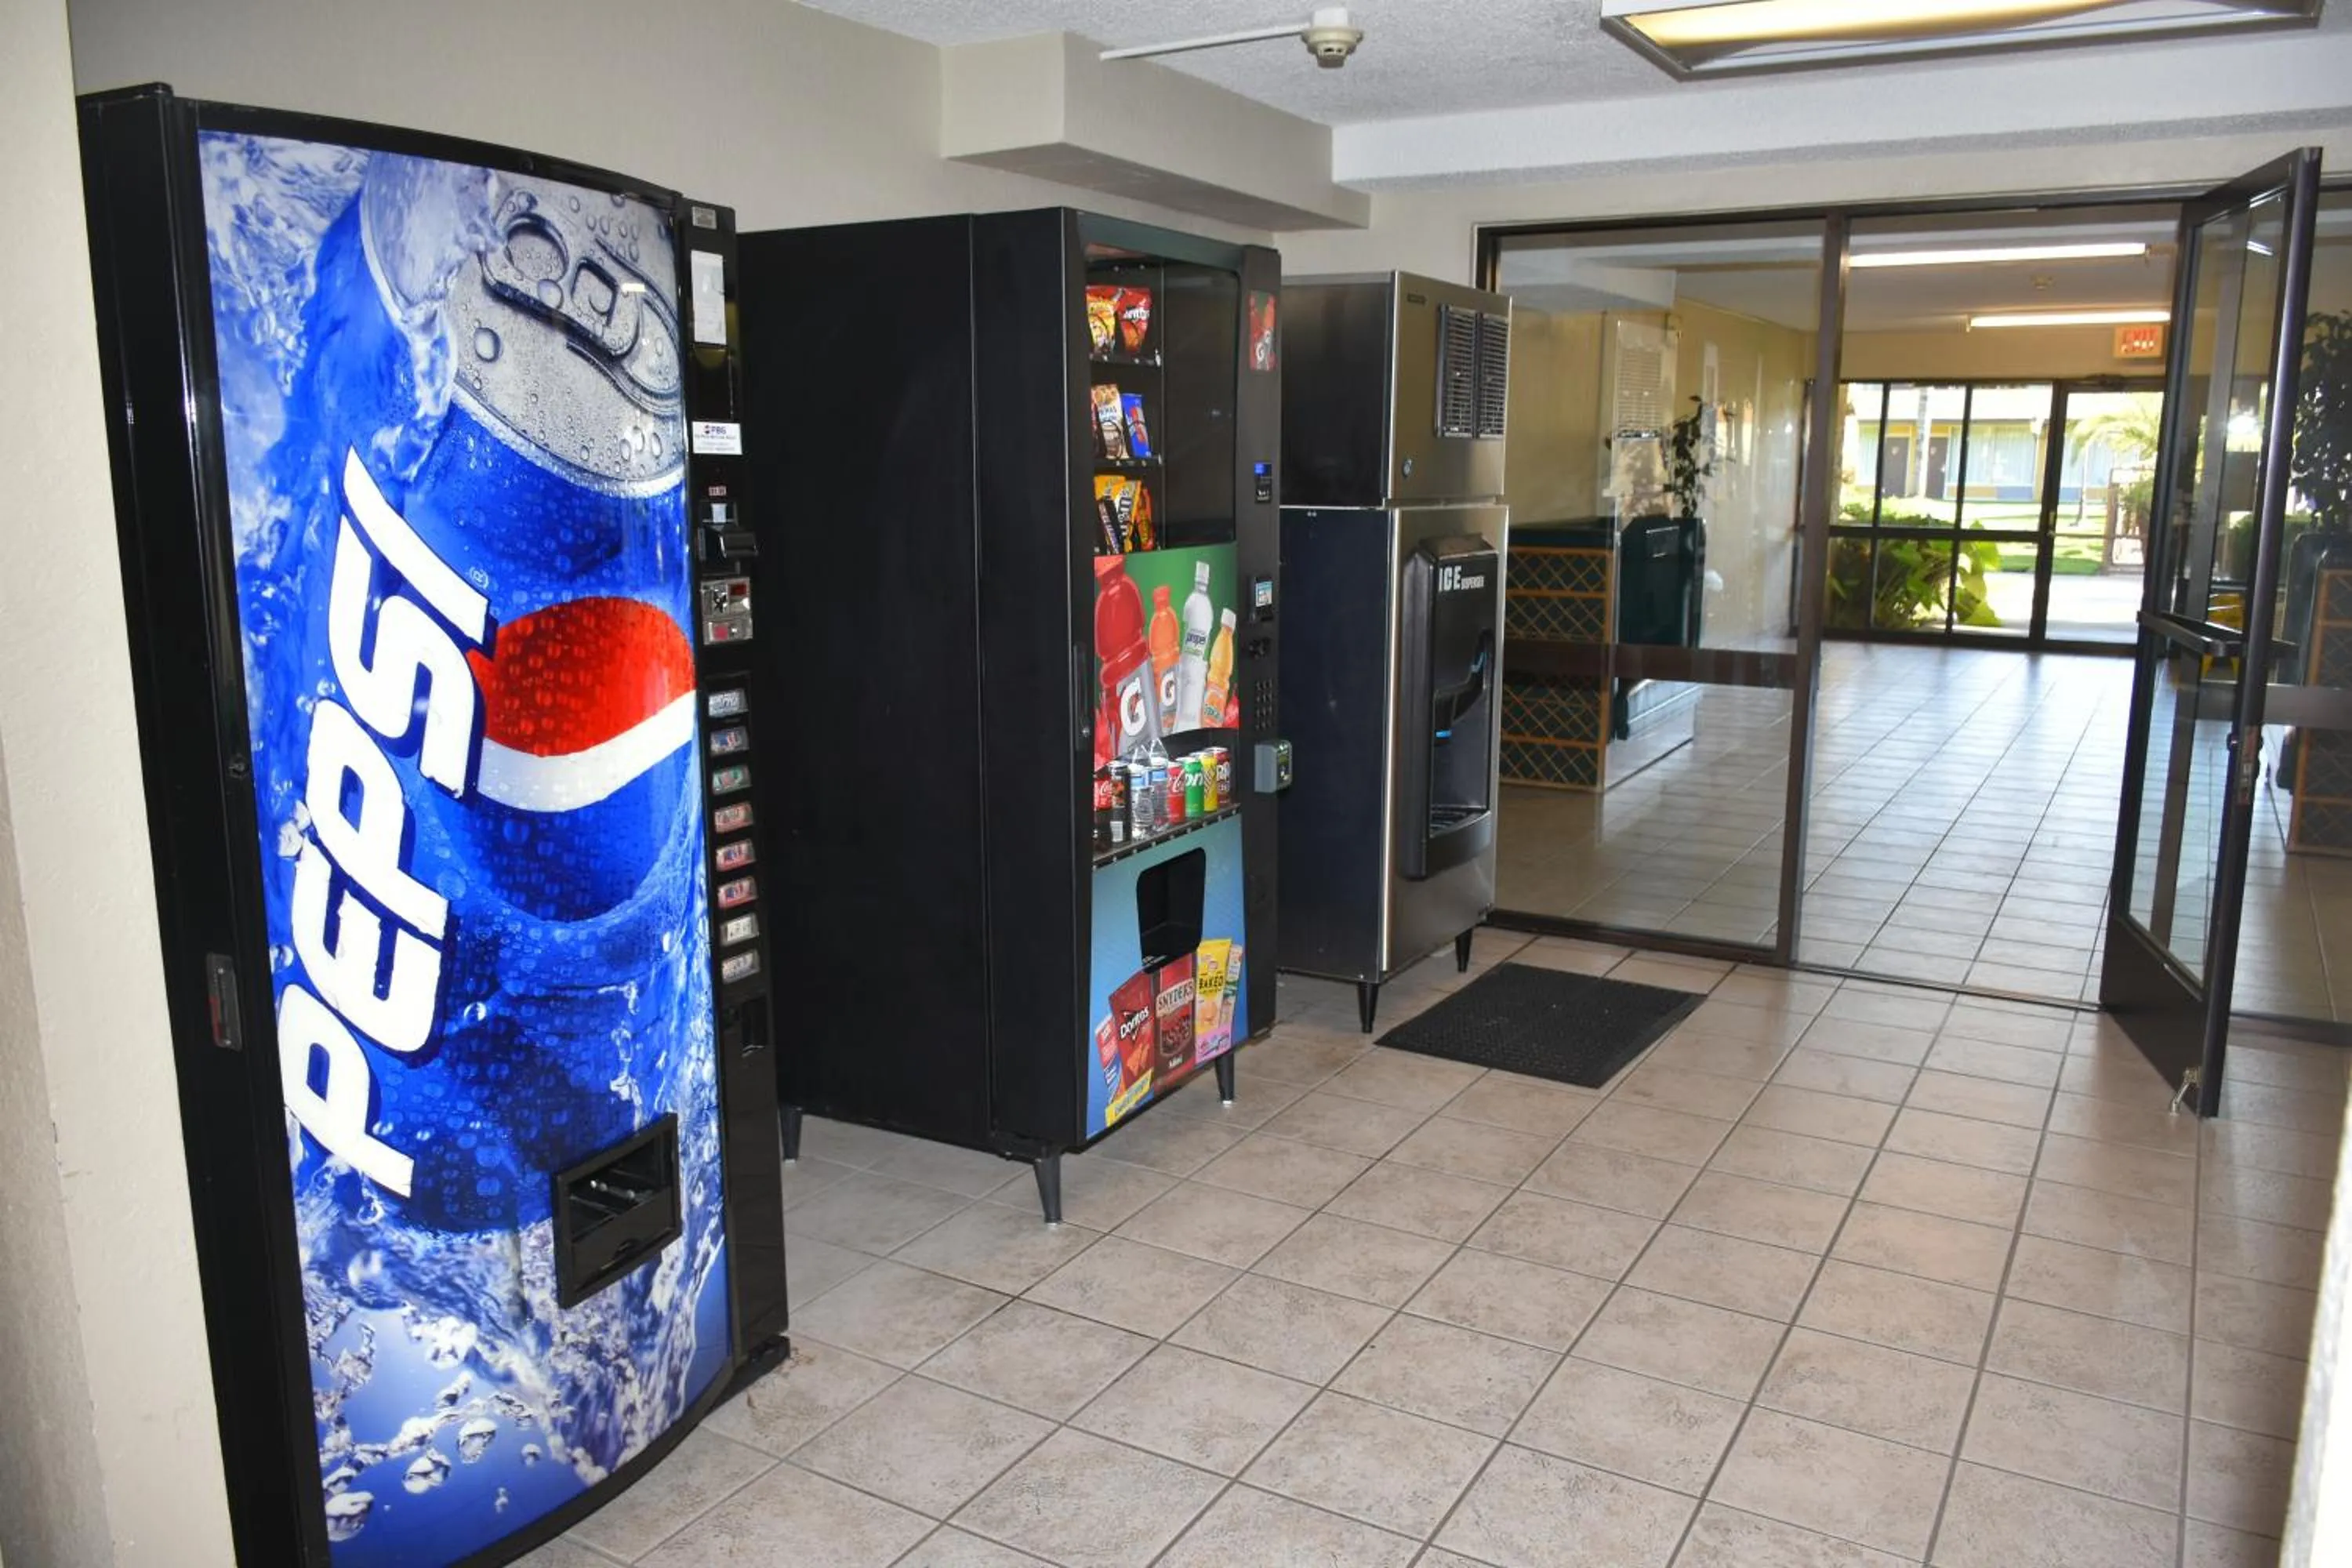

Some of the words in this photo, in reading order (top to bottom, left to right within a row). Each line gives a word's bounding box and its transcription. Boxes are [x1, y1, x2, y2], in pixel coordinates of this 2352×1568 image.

[1439, 564, 1462, 593] ICE
[278, 445, 490, 1199] PEPSI
[1120, 1007, 1149, 1040] Doritos
